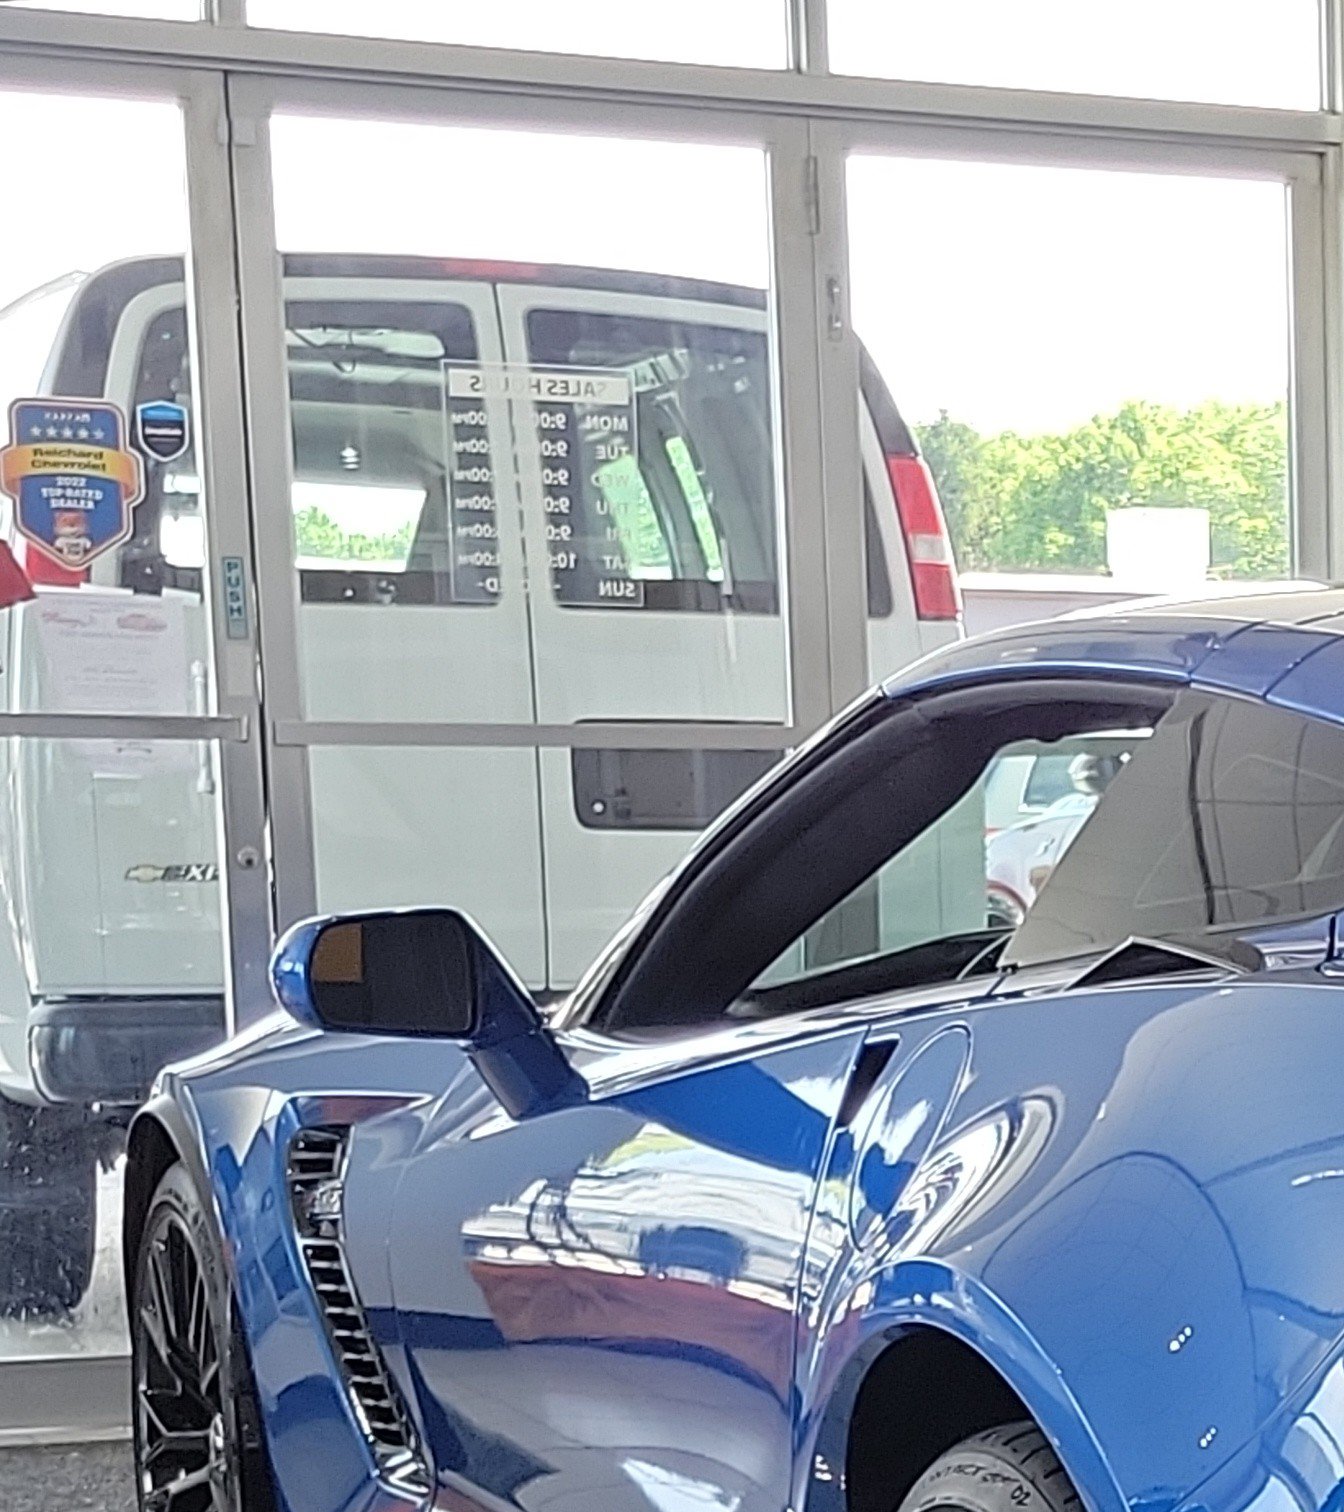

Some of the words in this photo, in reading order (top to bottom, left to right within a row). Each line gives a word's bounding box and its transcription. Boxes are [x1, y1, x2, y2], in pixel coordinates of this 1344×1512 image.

[33, 447, 104, 460] Reichard
[31, 460, 107, 472] Chevrolet
[55, 476, 87, 487] 2022
[50, 499, 95, 510] DEALER
[226, 560, 243, 618] PUSH
